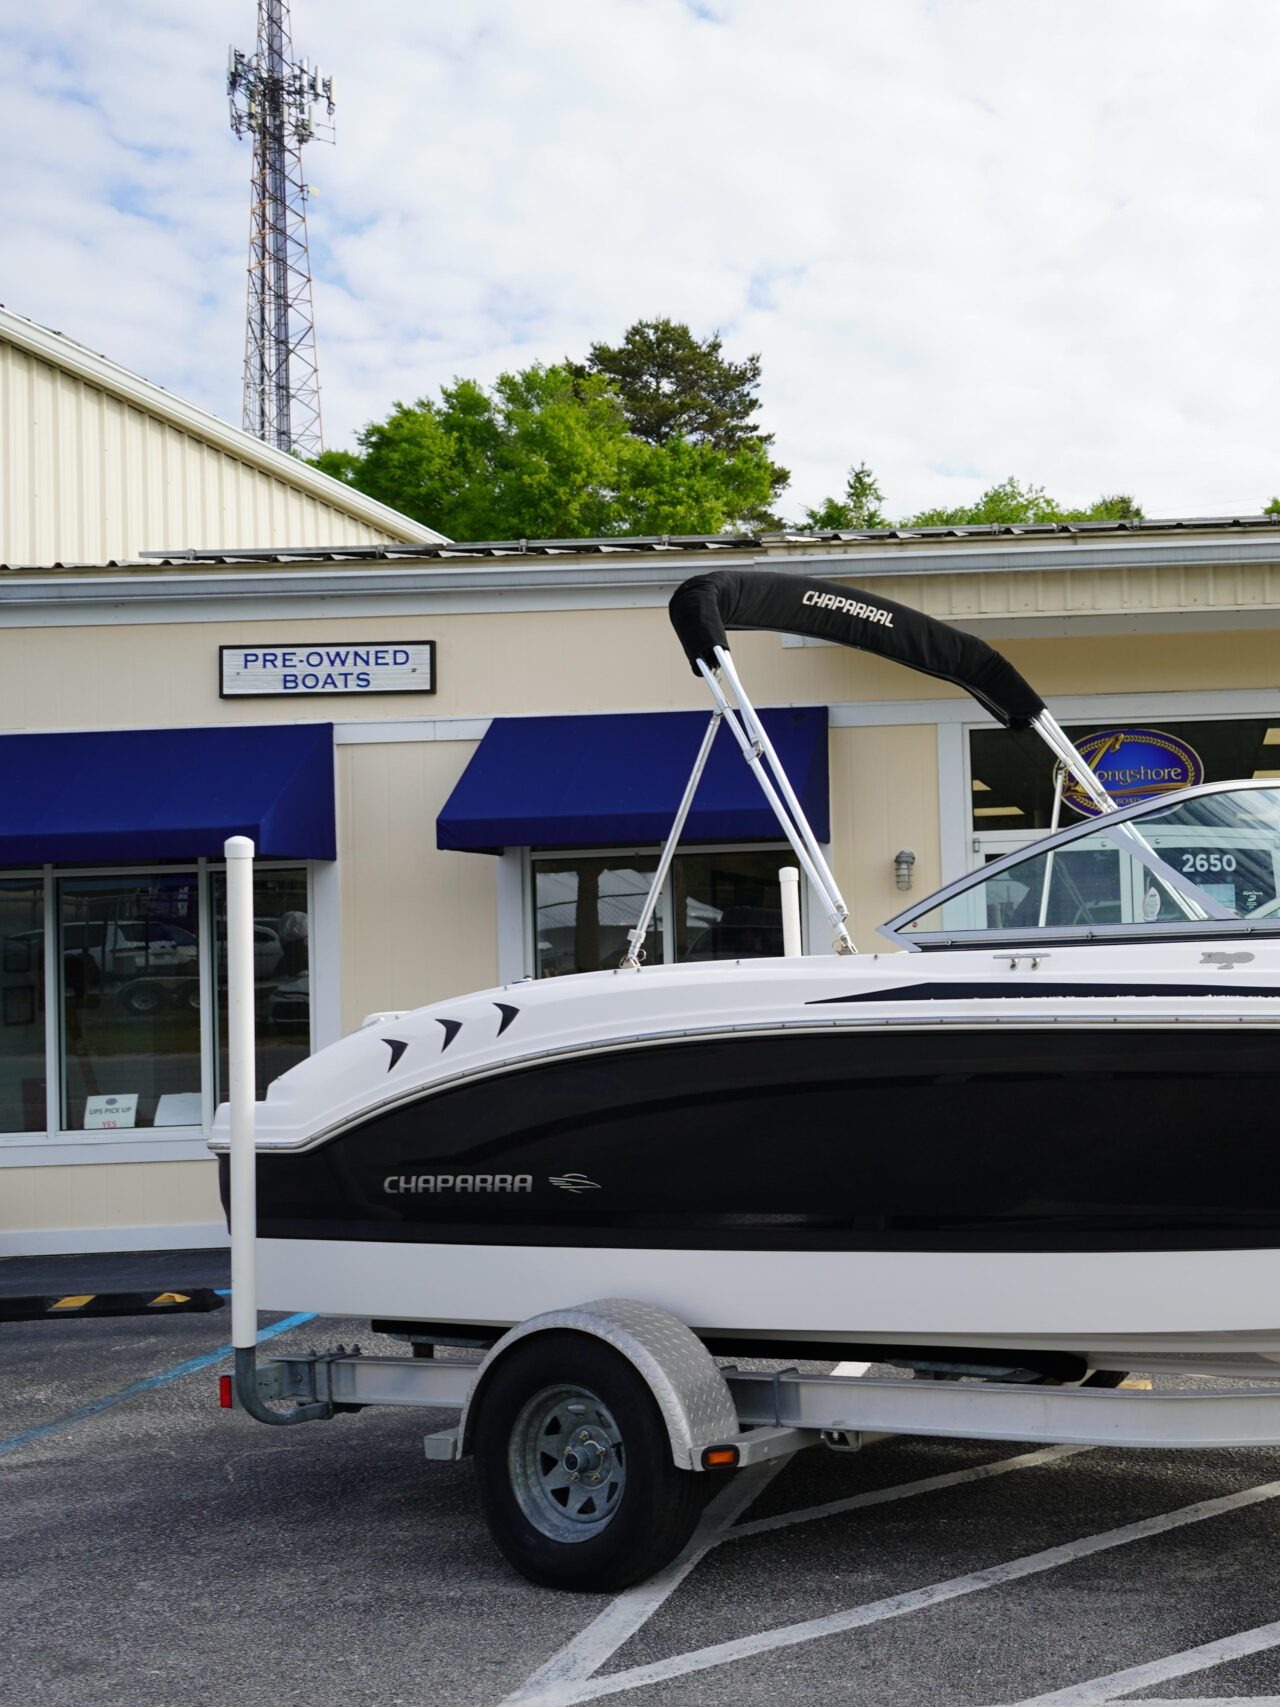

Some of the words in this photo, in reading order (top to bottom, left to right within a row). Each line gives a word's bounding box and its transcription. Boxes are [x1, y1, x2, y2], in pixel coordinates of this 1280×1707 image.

[802, 590, 894, 628] CHAPARRAL
[243, 649, 410, 669] PRE-OWNED
[282, 672, 371, 690] BOATS
[1182, 853, 1237, 873] 2650
[102, 1120, 117, 1128] YES
[383, 1174, 533, 1193] CHAPARRA
